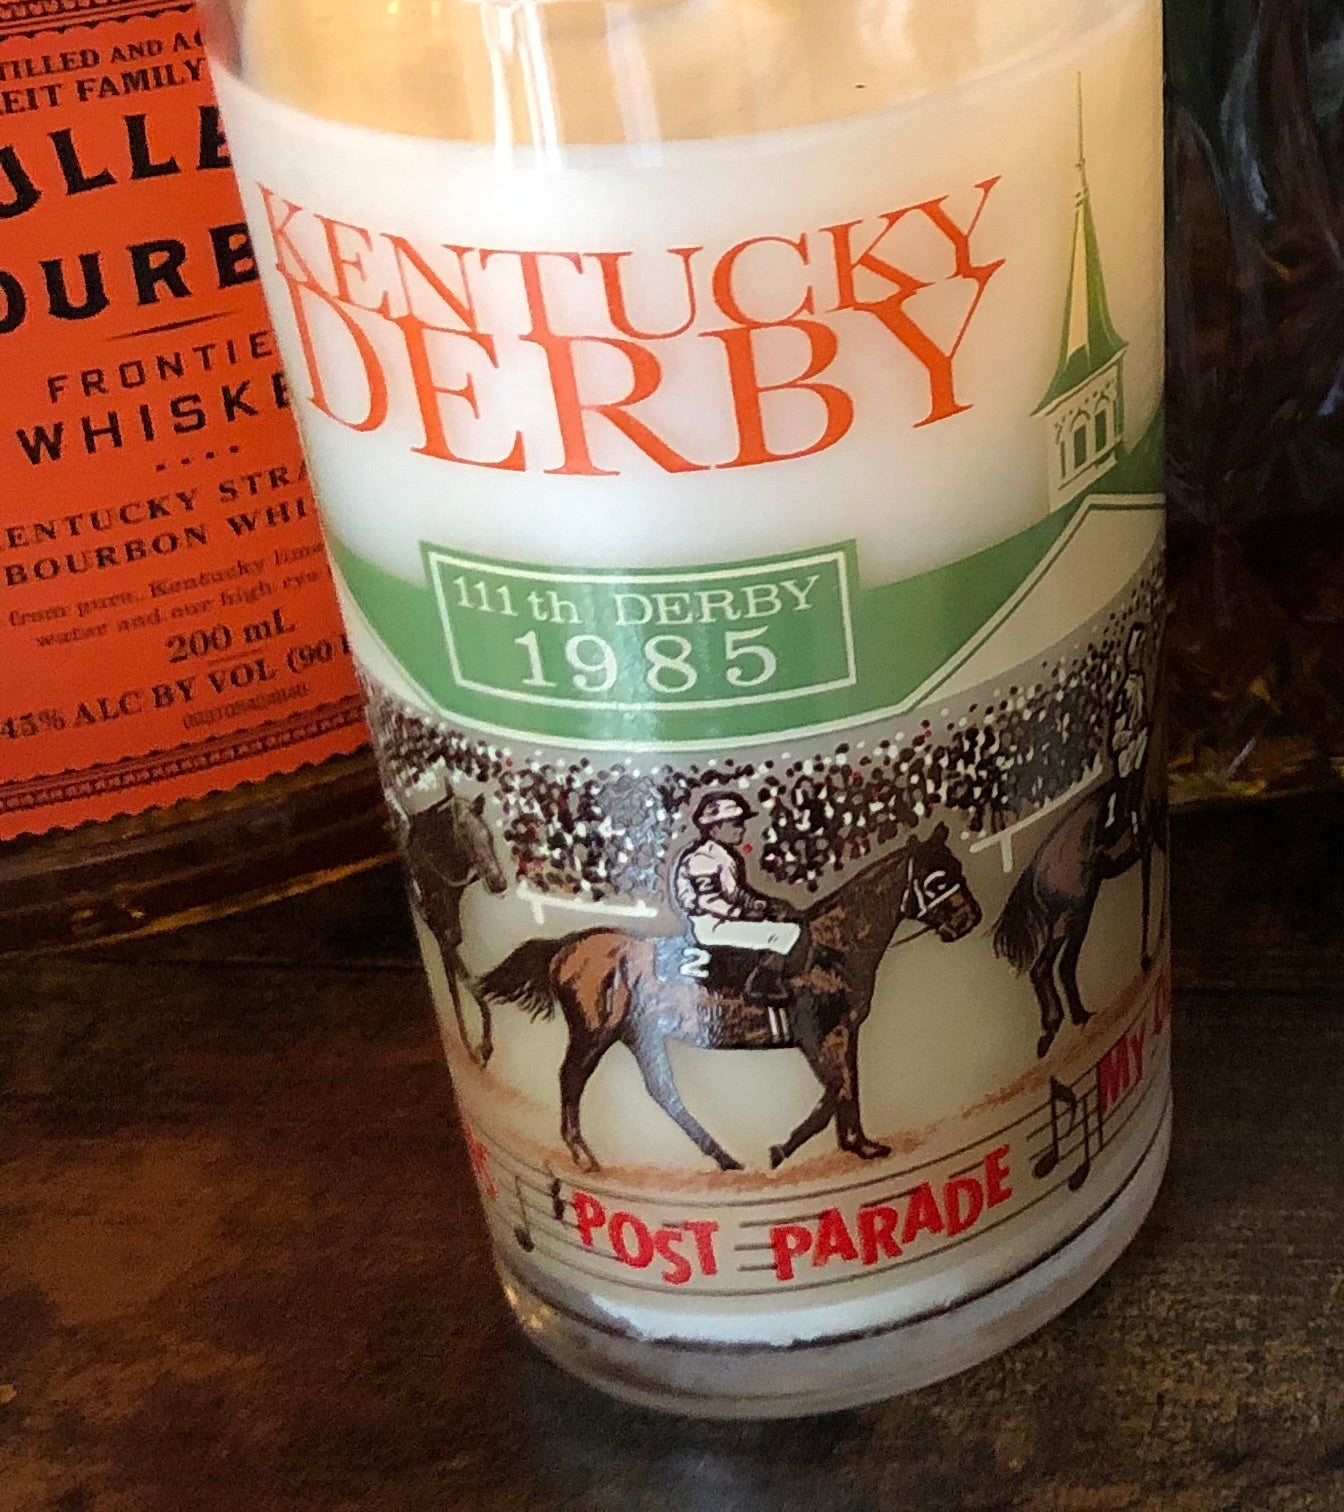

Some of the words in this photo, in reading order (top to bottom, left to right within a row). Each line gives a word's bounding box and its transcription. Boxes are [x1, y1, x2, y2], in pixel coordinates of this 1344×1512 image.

[110, 39, 163, 65] AND
[0, 83, 62, 115] EIT
[76, 56, 208, 102] FAMILY
[257, 175, 1002, 341] KENTUCKY
[275, 258, 1007, 476] DERBY
[0, 488, 199, 553] ENTUCKY
[4, 524, 208, 587] BOURBON
[148, 557, 265, 598] Kentucky
[220, 580, 274, 608] high
[453, 575, 584, 625] 111th
[614, 574, 820, 626] DERBY
[165, 623, 232, 665] 200
[243, 608, 297, 645] mL
[513, 624, 778, 693] 1985
[73, 690, 144, 730] ALC
[151, 676, 198, 709] BY
[208, 656, 279, 694] VOL
[679, 947, 712, 979] 2
[570, 1190, 720, 1286] POST
[770, 1143, 1014, 1281] PARADE
